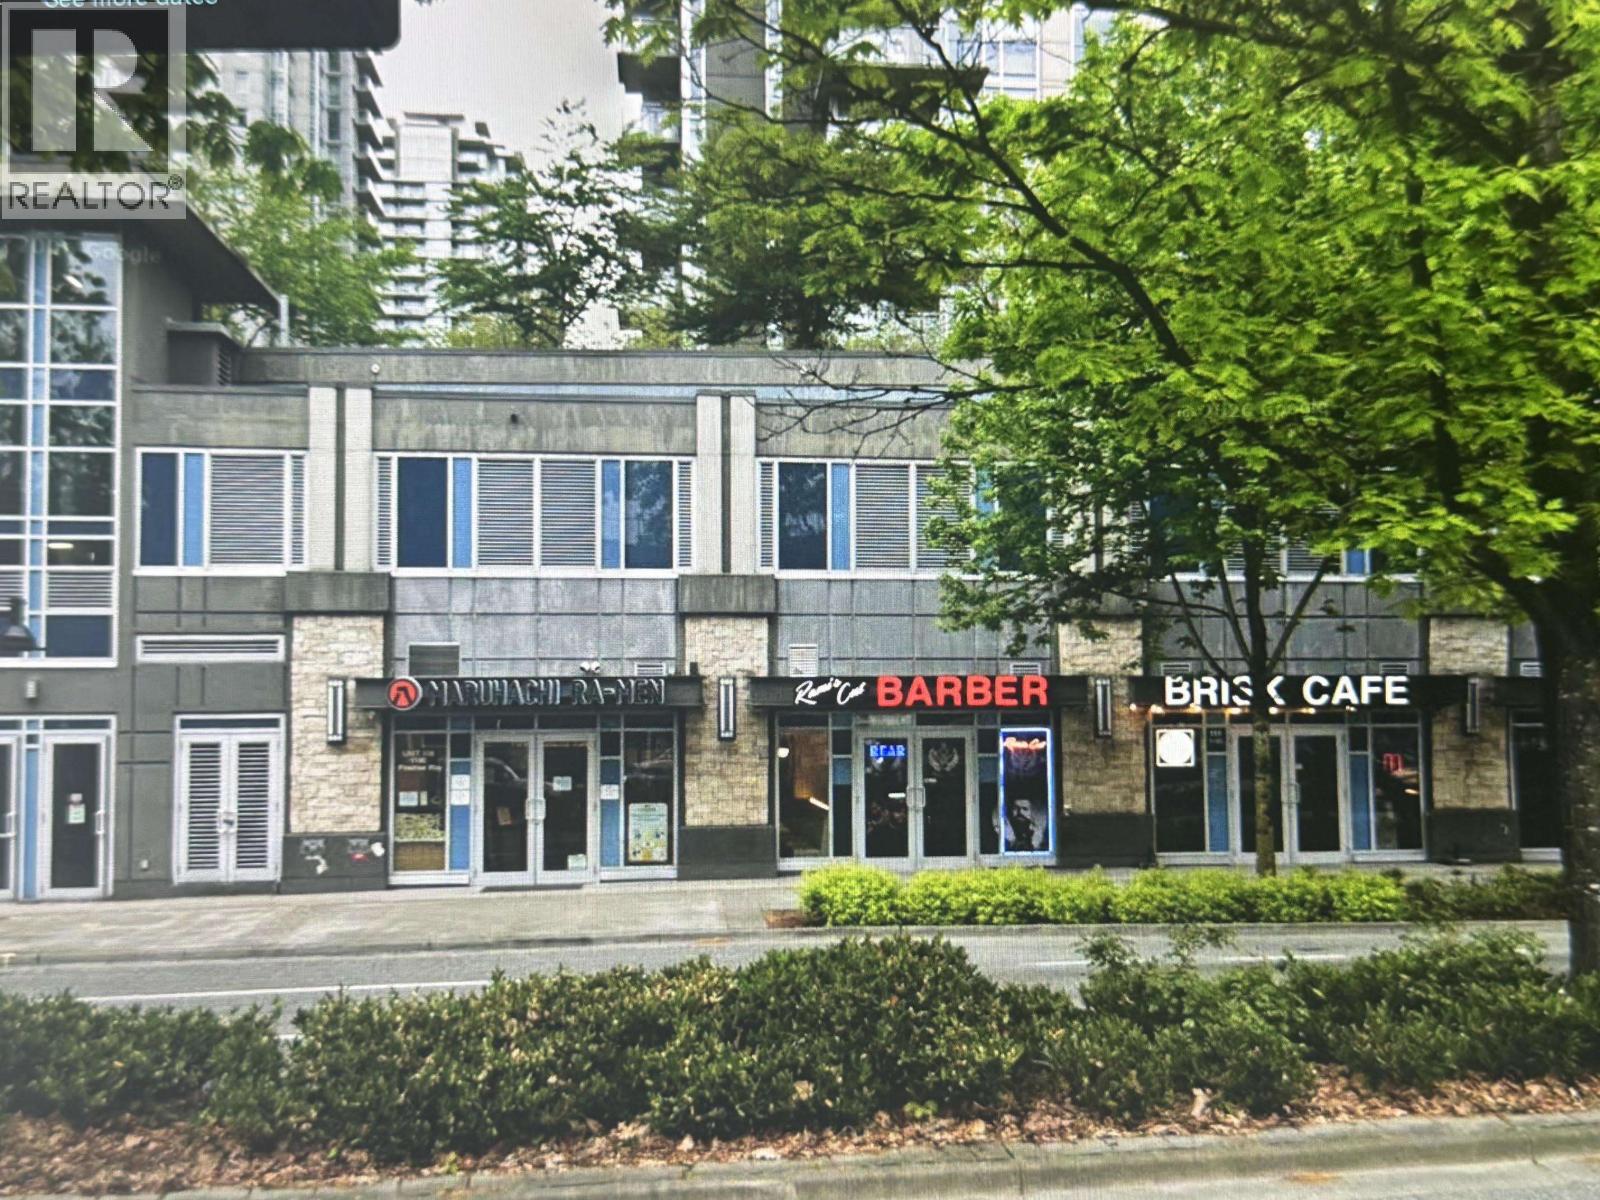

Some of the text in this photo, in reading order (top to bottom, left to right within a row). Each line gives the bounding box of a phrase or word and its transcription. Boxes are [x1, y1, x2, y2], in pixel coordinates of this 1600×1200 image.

[429, 678, 666, 706] MARUHACHI RA-MEN
[876, 675, 1048, 707] BARBER
[1164, 675, 1410, 706] BRISK CAFE
